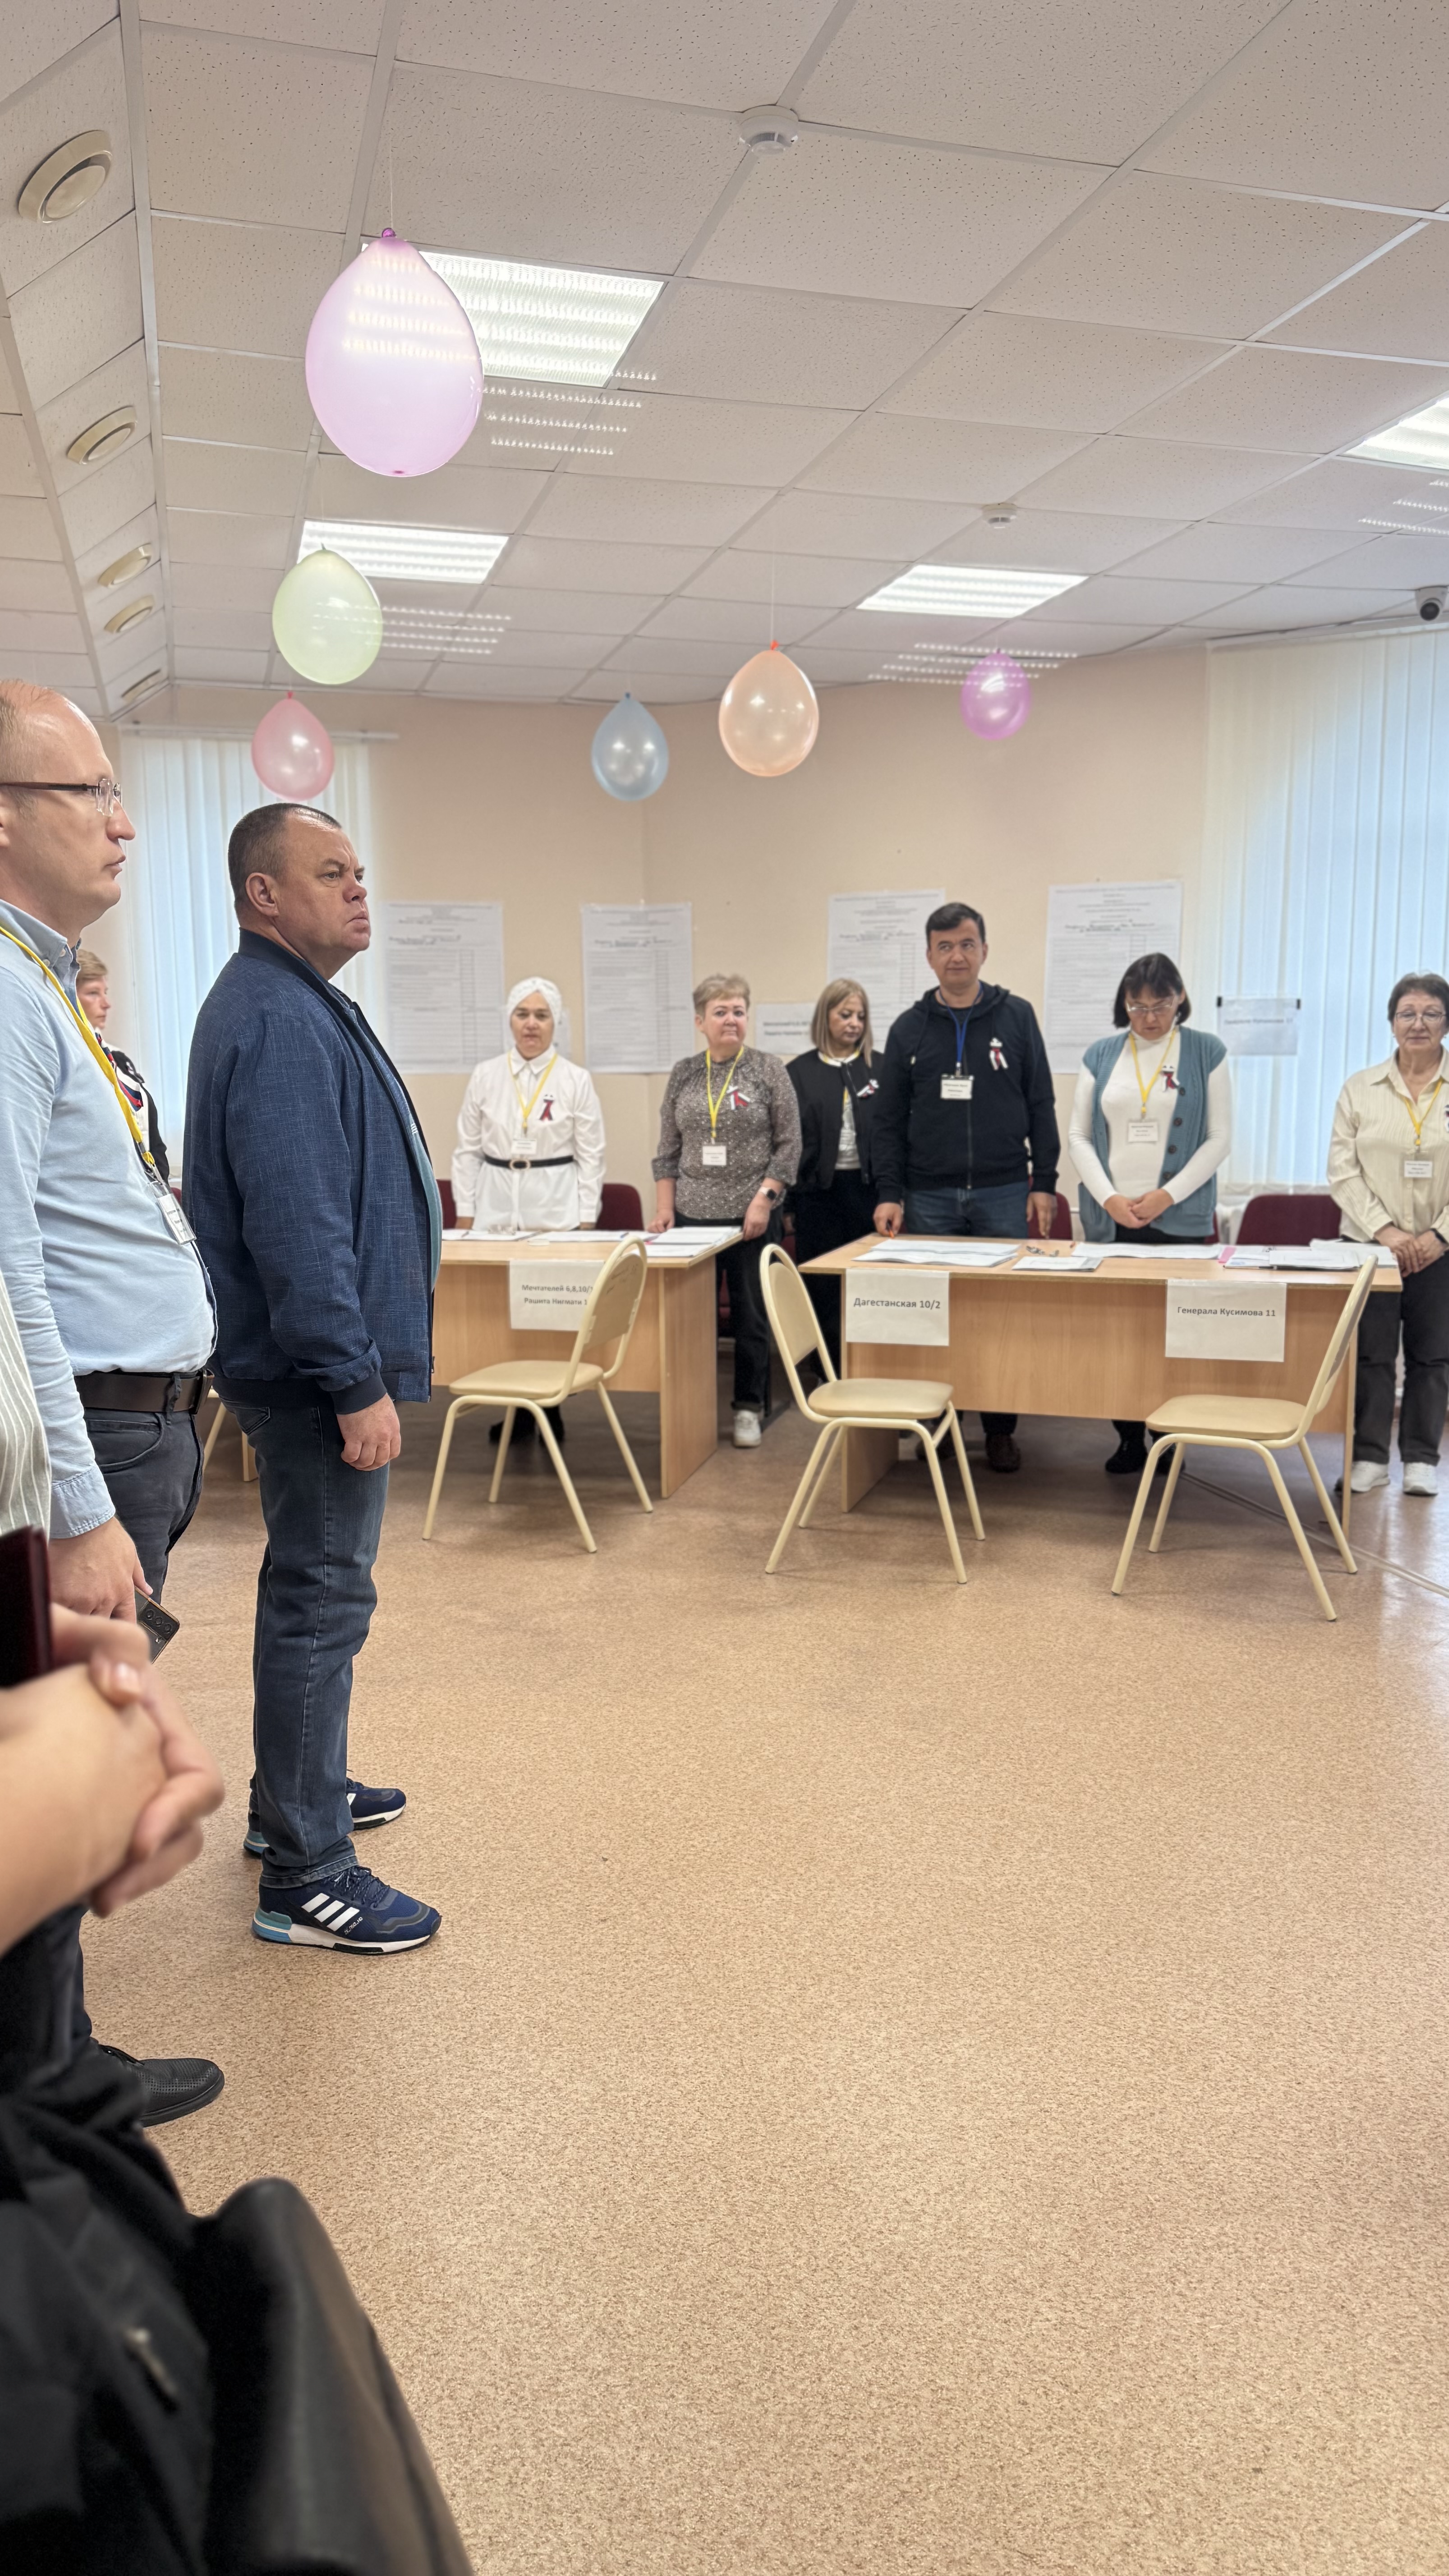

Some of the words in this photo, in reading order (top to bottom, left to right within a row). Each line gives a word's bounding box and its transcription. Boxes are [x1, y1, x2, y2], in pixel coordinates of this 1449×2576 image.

[853, 1297, 916, 1308] Дагестанская
[920, 1300, 941, 1310] 10/2
[1178, 1306, 1218, 1316] Генерала
[1220, 1308, 1263, 1316] Кусимова
